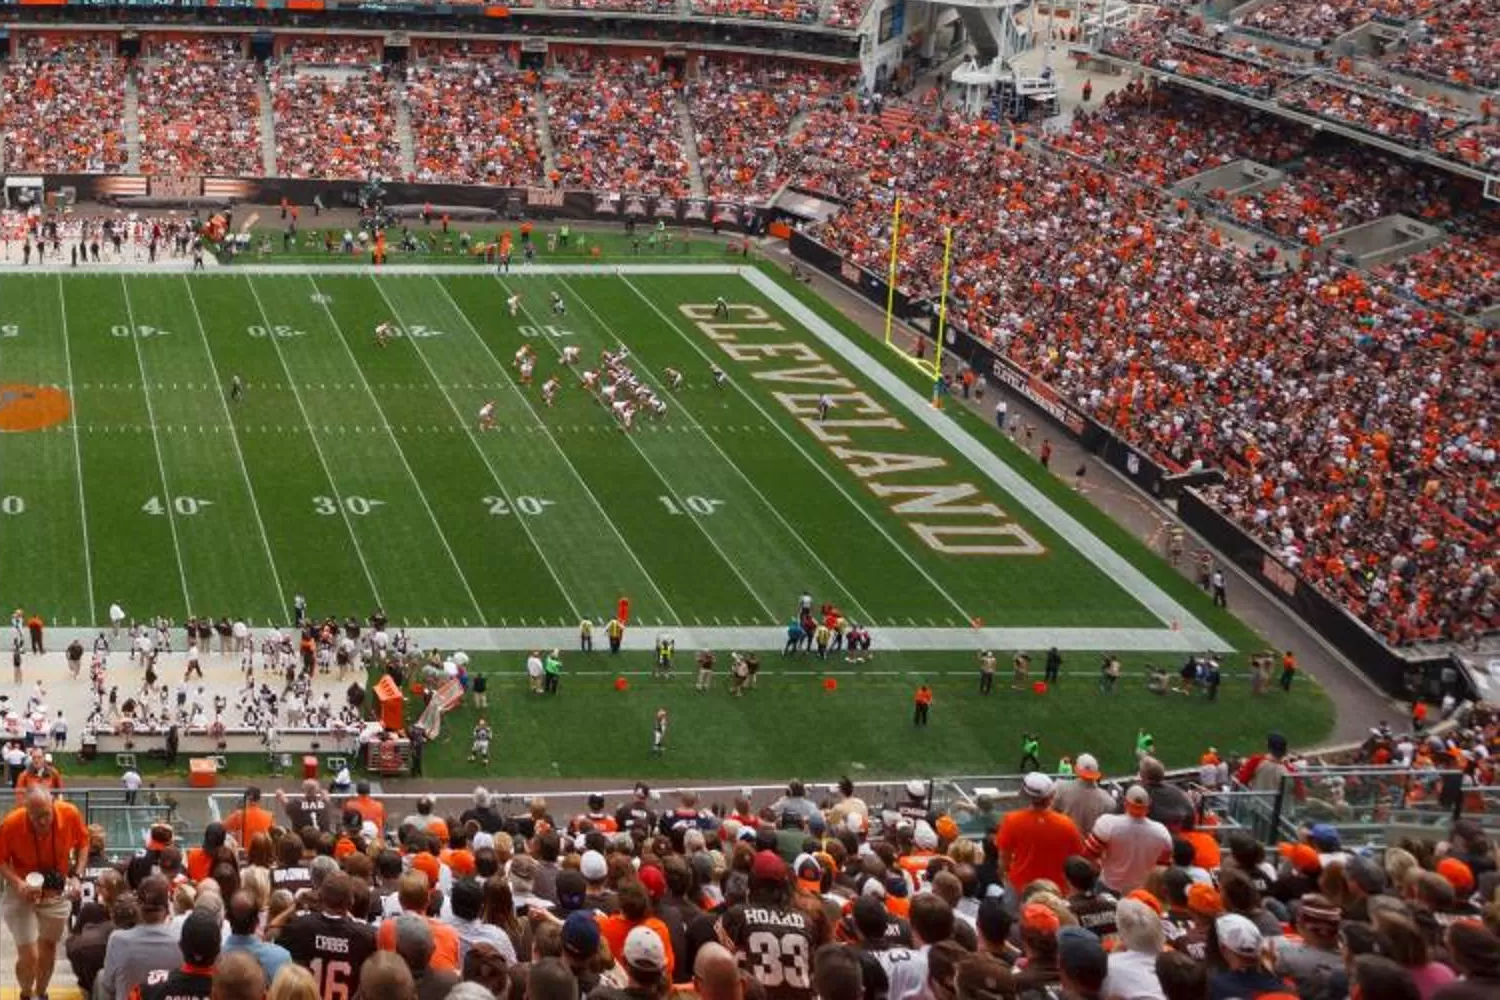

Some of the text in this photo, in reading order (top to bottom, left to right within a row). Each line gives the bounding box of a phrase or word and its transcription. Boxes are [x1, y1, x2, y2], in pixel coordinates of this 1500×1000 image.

[678, 303, 1047, 555] CLEVELAND
[141, 495, 199, 515] 40
[312, 495, 372, 515] 30
[482, 495, 544, 515] 20
[657, 495, 716, 515] 10
[310, 957, 352, 1000] 16
[749, 931, 811, 989] 33
